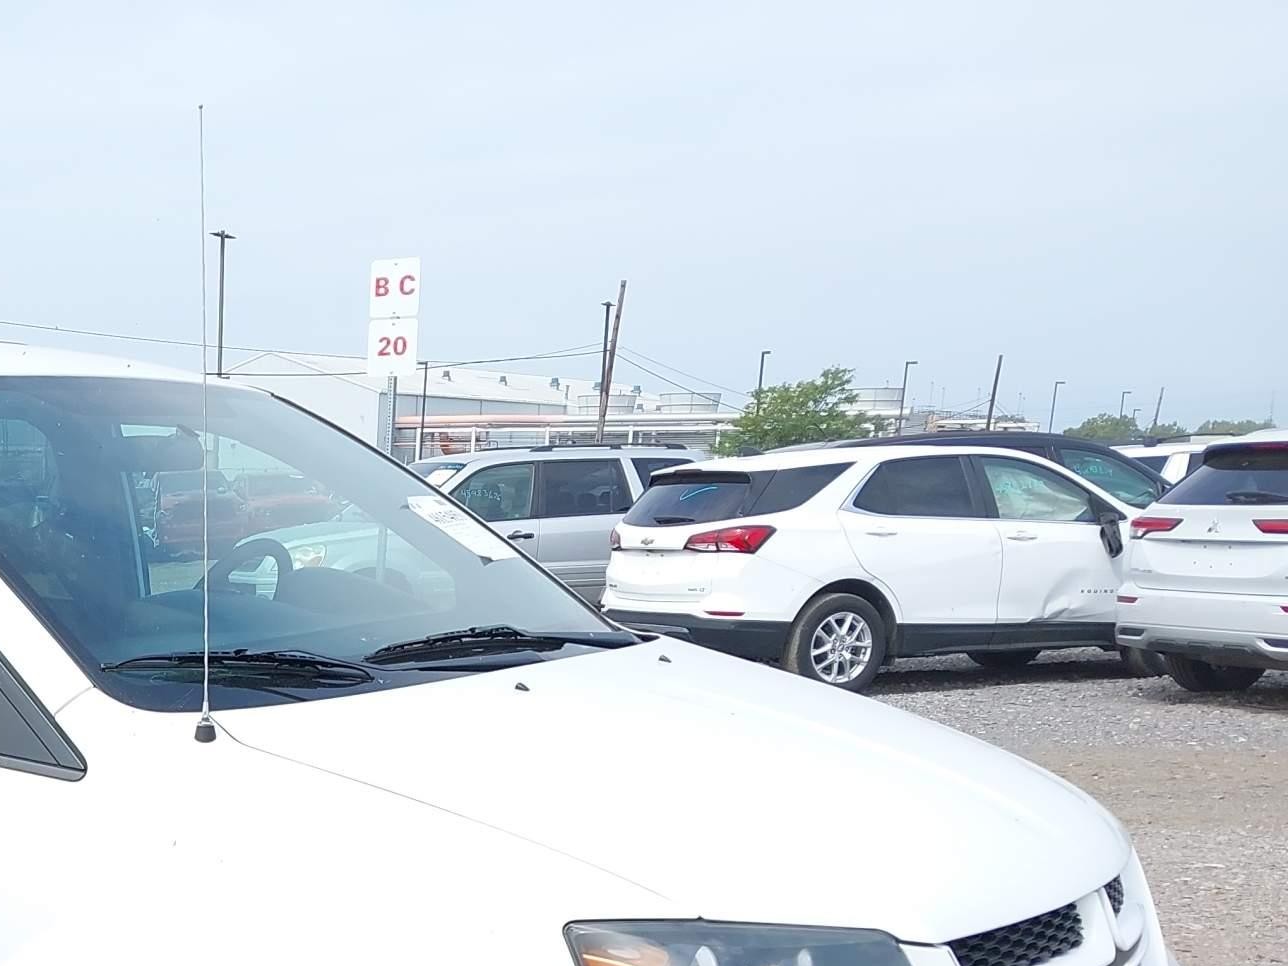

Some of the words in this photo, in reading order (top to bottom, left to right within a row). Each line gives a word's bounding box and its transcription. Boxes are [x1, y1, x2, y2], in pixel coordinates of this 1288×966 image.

[374, 276, 390, 298] B
[399, 274, 416, 296] C
[377, 335, 408, 357] 20
